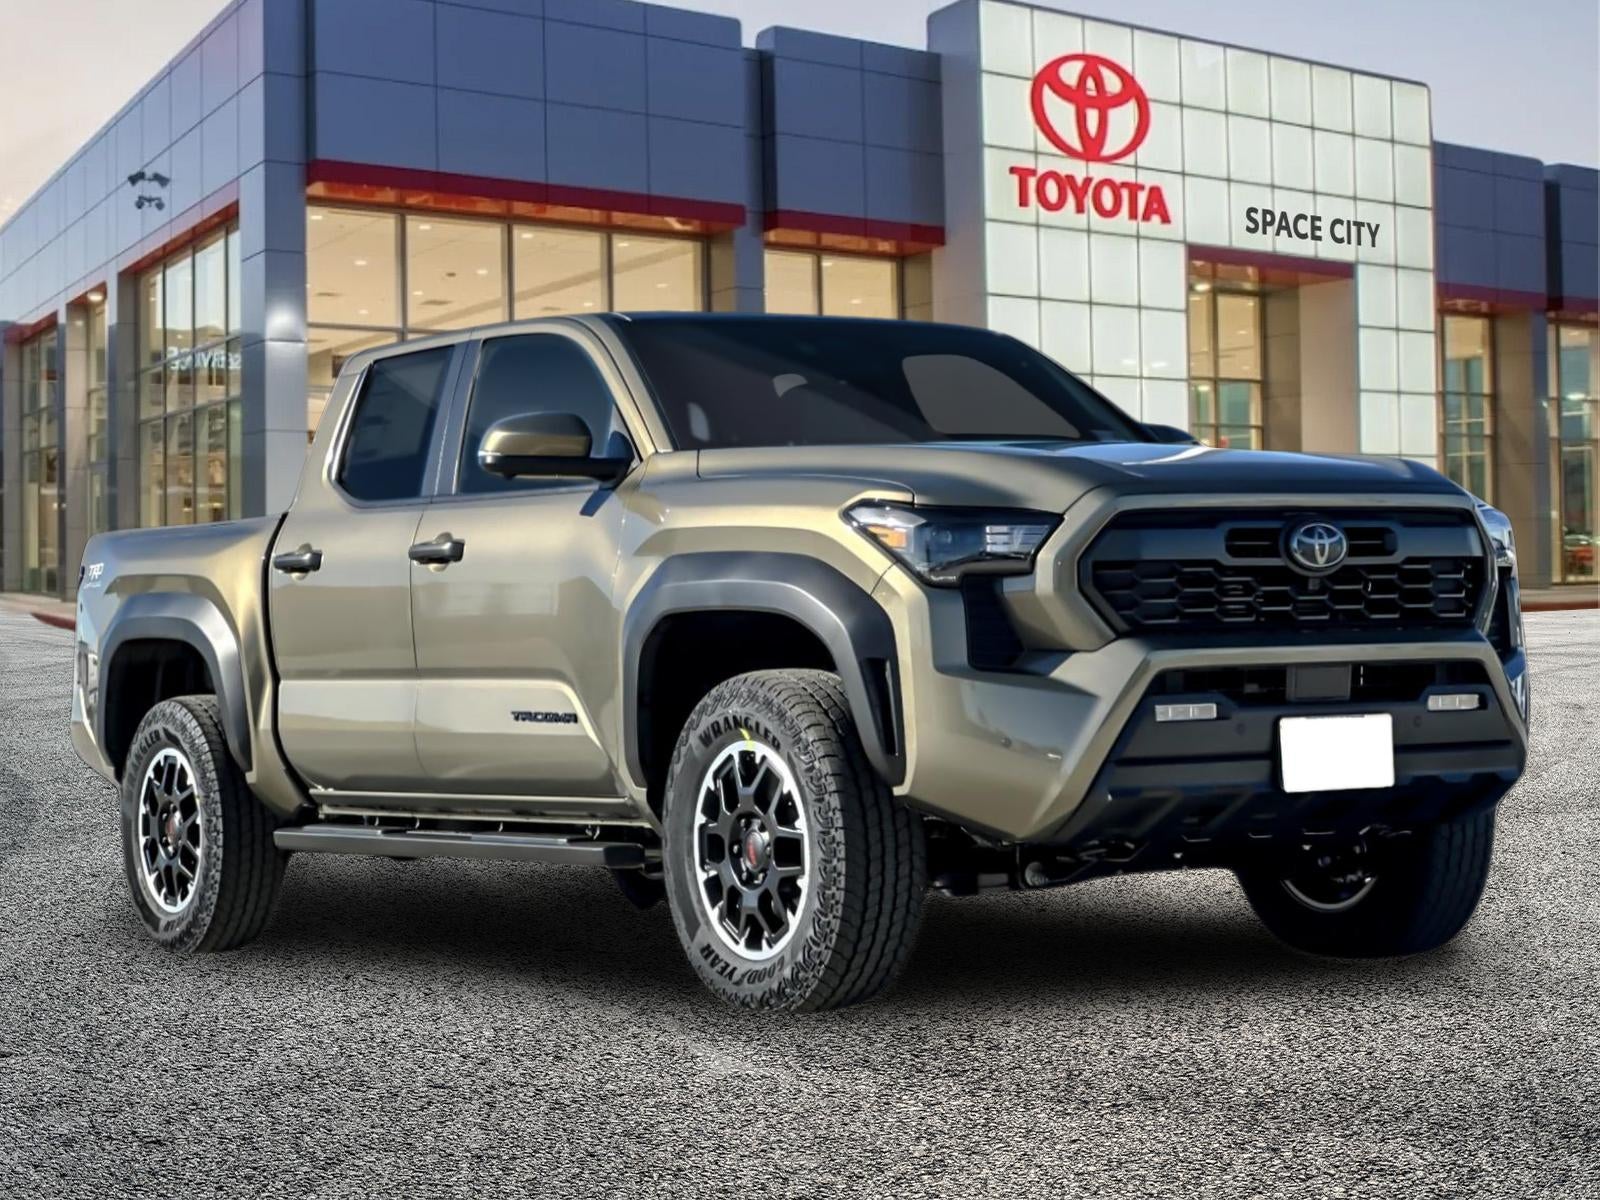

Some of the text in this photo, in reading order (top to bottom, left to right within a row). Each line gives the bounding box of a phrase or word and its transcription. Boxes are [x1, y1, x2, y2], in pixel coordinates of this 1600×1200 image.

[1009, 166, 1171, 224] TOYOTA
[1245, 206, 1381, 248] SPACE CITY
[511, 711, 578, 723] TACOMA
[699, 715, 782, 748] WRANGLER
